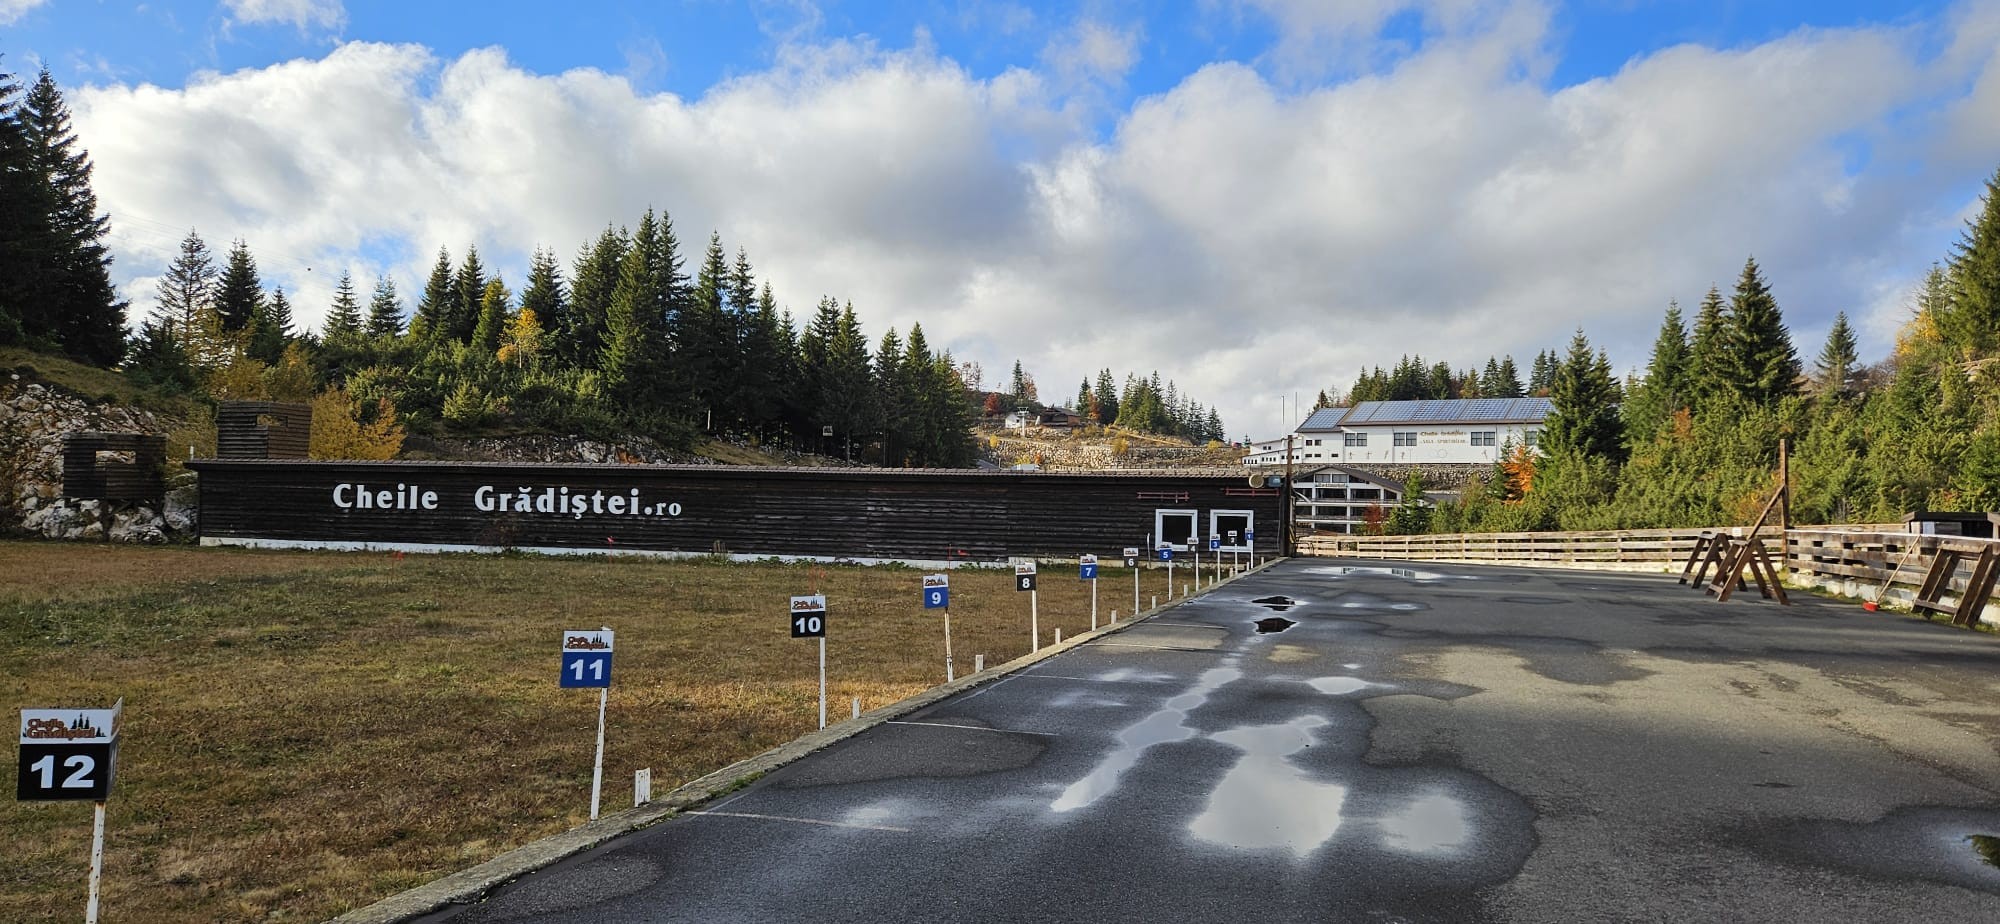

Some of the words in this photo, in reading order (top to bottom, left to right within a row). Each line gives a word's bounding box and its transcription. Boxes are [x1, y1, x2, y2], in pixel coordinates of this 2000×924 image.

[332, 483, 439, 510] Cheile
[1163, 551, 1169, 559] 5
[1128, 558, 1135, 567] 6
[1085, 567, 1093, 577] 7
[1022, 577, 1031, 589] 8
[931, 591, 942, 605] 9
[795, 616, 822, 634] 10
[570, 658, 604, 681] 11
[31, 755, 95, 788] 12
